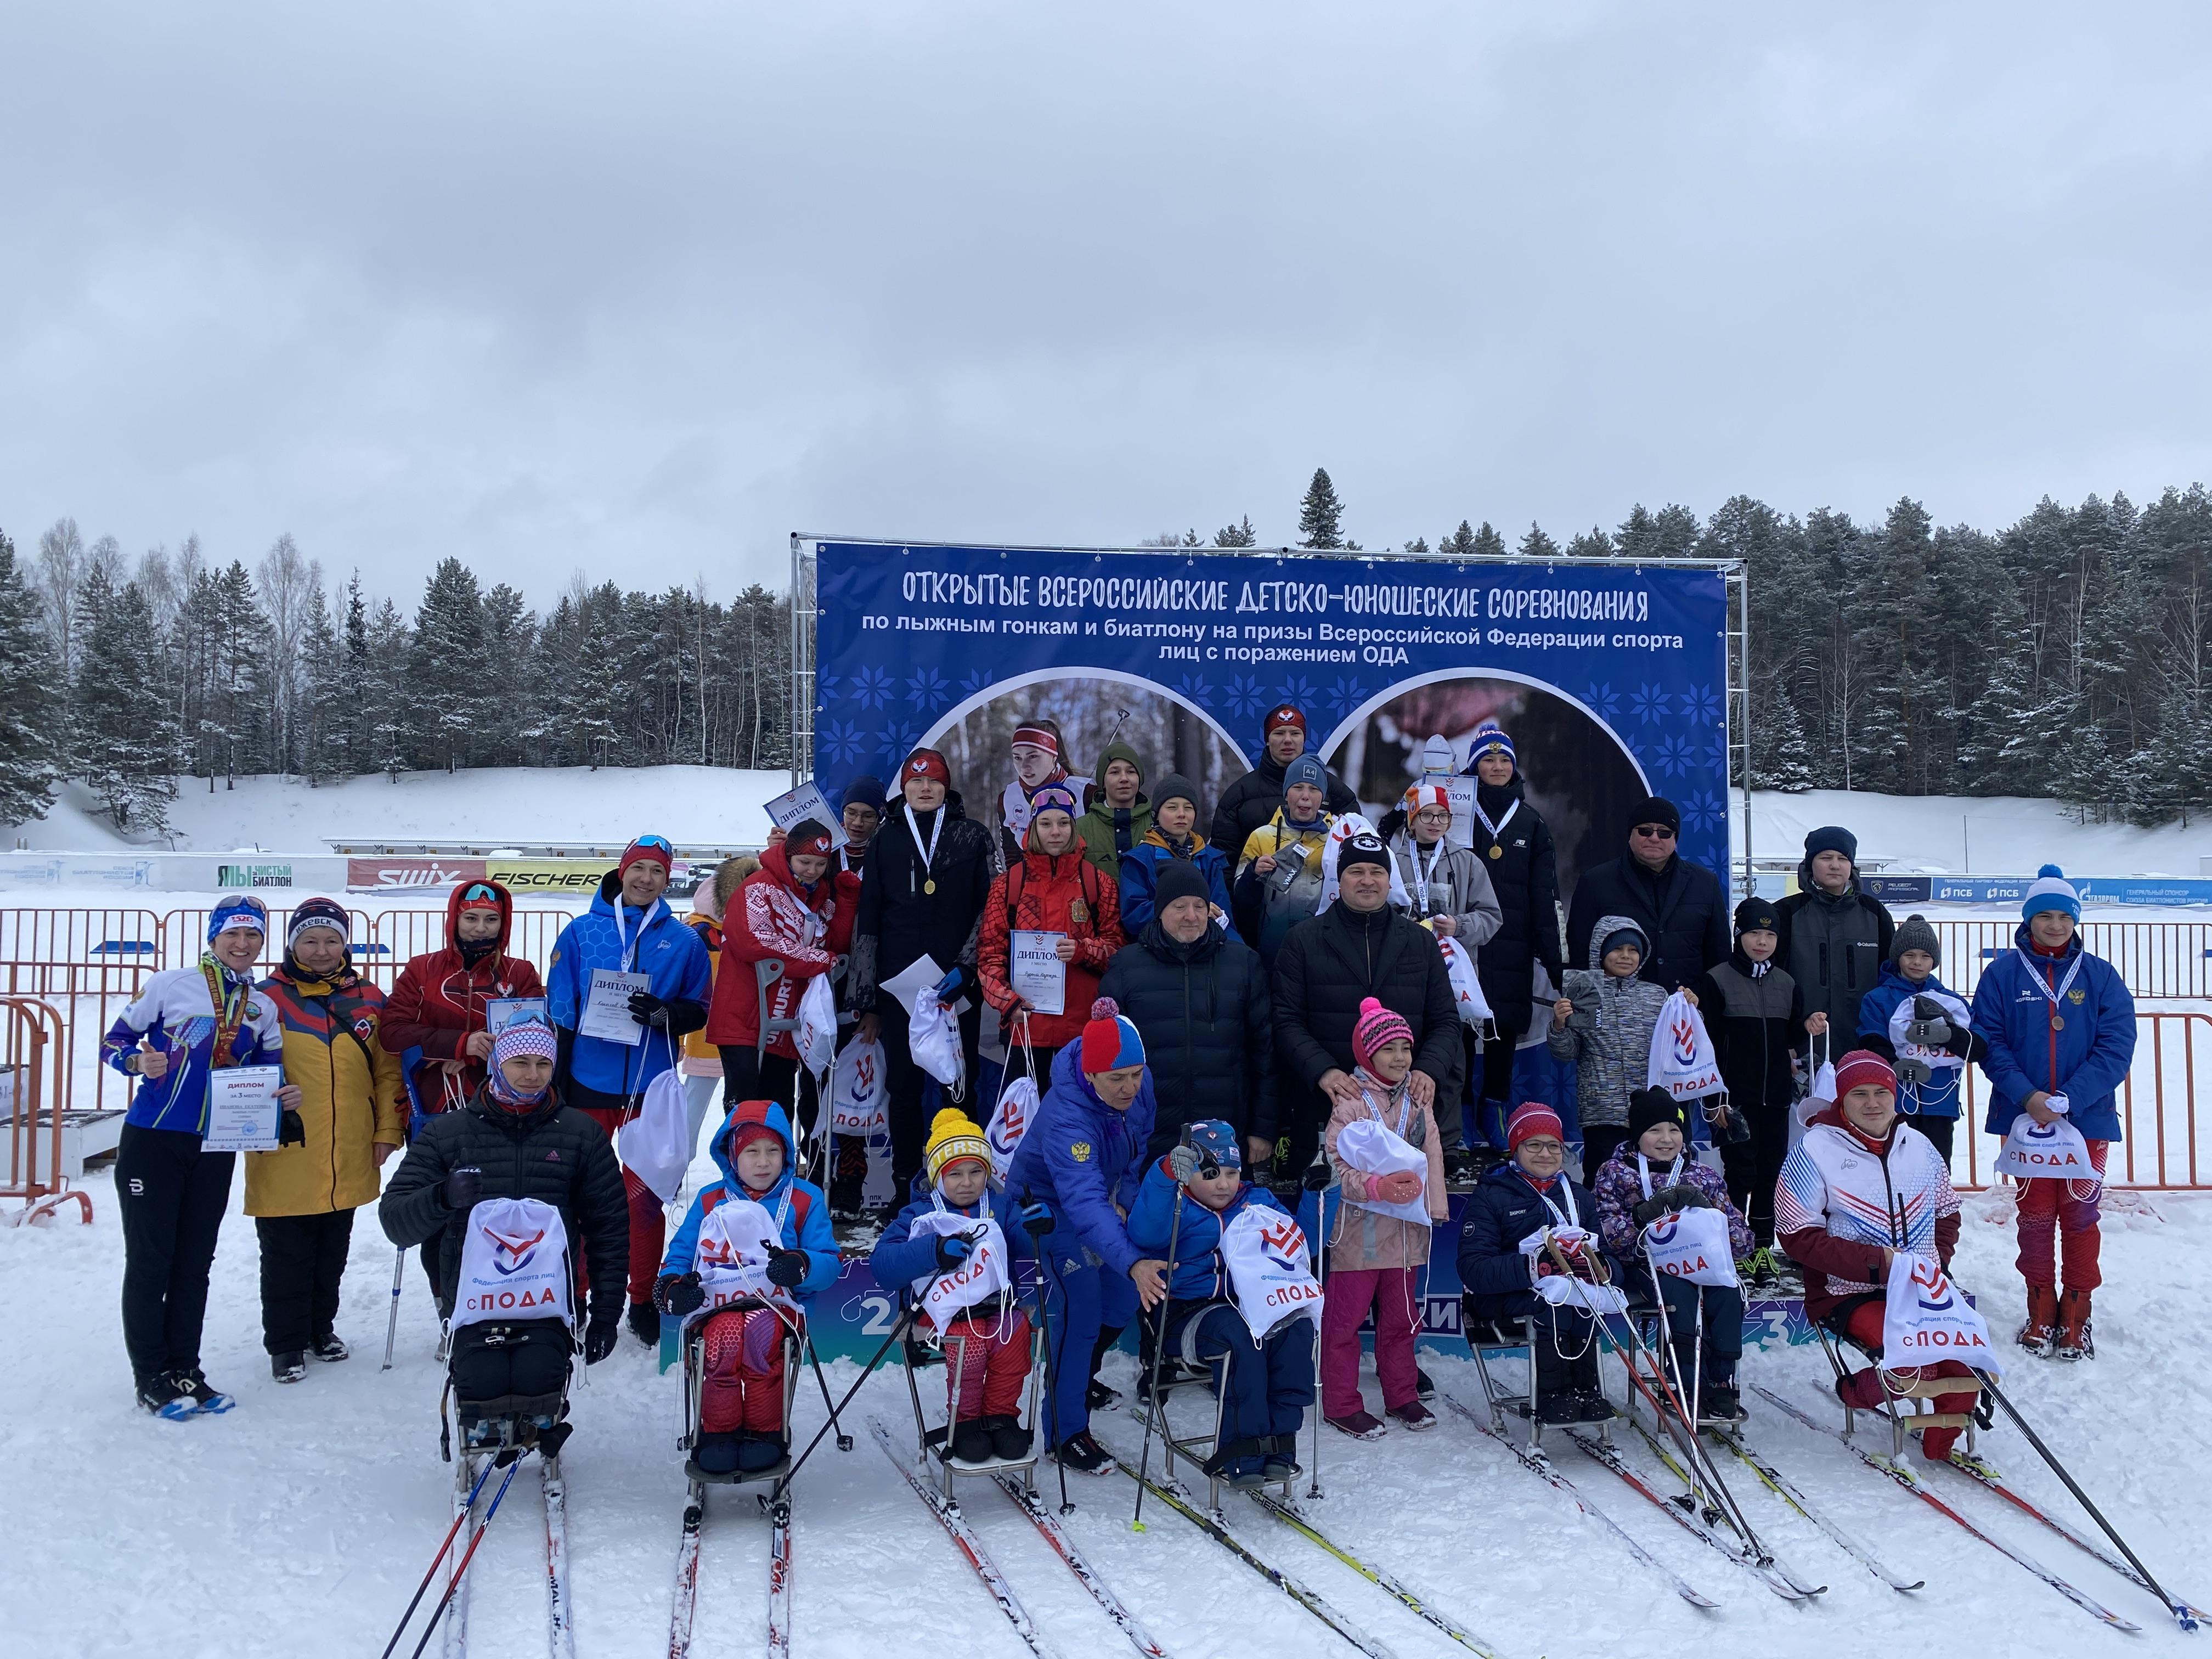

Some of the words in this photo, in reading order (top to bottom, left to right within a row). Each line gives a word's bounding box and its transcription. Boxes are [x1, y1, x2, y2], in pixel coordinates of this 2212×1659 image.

[902, 571, 1030, 606] ОТКРЫТЫЕ
[1039, 576, 1228, 611] ВСЕРОССИЙСКИЕ
[1235, 581, 1480, 618] ДЕТСКО-ЮНОШЕСКИЕ
[1488, 588, 1648, 622] СОРЕВНОВАНИЯ
[862, 616, 889, 629] по
[895, 616, 995, 633] лыжным
[1003, 620, 1079, 635] гонкам
[1085, 622, 1097, 635] и
[1104, 619, 1206, 642] биатлону
[1213, 625, 1237, 639] на
[1245, 625, 1312, 643] призы
[1319, 624, 1480, 645] Всероссийской
[1487, 628, 1605, 650] Федерации
[1612, 634, 1683, 651] спорта
[1159, 646, 1200, 662] лиц
[1206, 647, 1218, 660] с
[1224, 647, 1356, 664] поражением
[1363, 646, 1409, 666] ОДА
[780, 797, 820, 825] ДИПЛОМ
[1482, 816, 1493, 831] ПОДА
[255, 864, 291, 876] ЧИСТЫЙ
[1283, 868, 1297, 885] VMAX
[252, 877, 291, 887] БИАТЛОН
[492, 873, 602, 885] FISCHER
[1017, 951, 1060, 961] ДИПЛОМ
[594, 980, 644, 992] ДИПЛОМ
[2041, 983, 2054, 998] ПОДА
[767, 976, 794, 1045] UMURT
[1062, 1264, 1081, 1277] adidas
[514, 1274, 539, 1283] спорта
[861, 1297, 891, 1335] 2
[1761, 1311, 1789, 1347] 3
